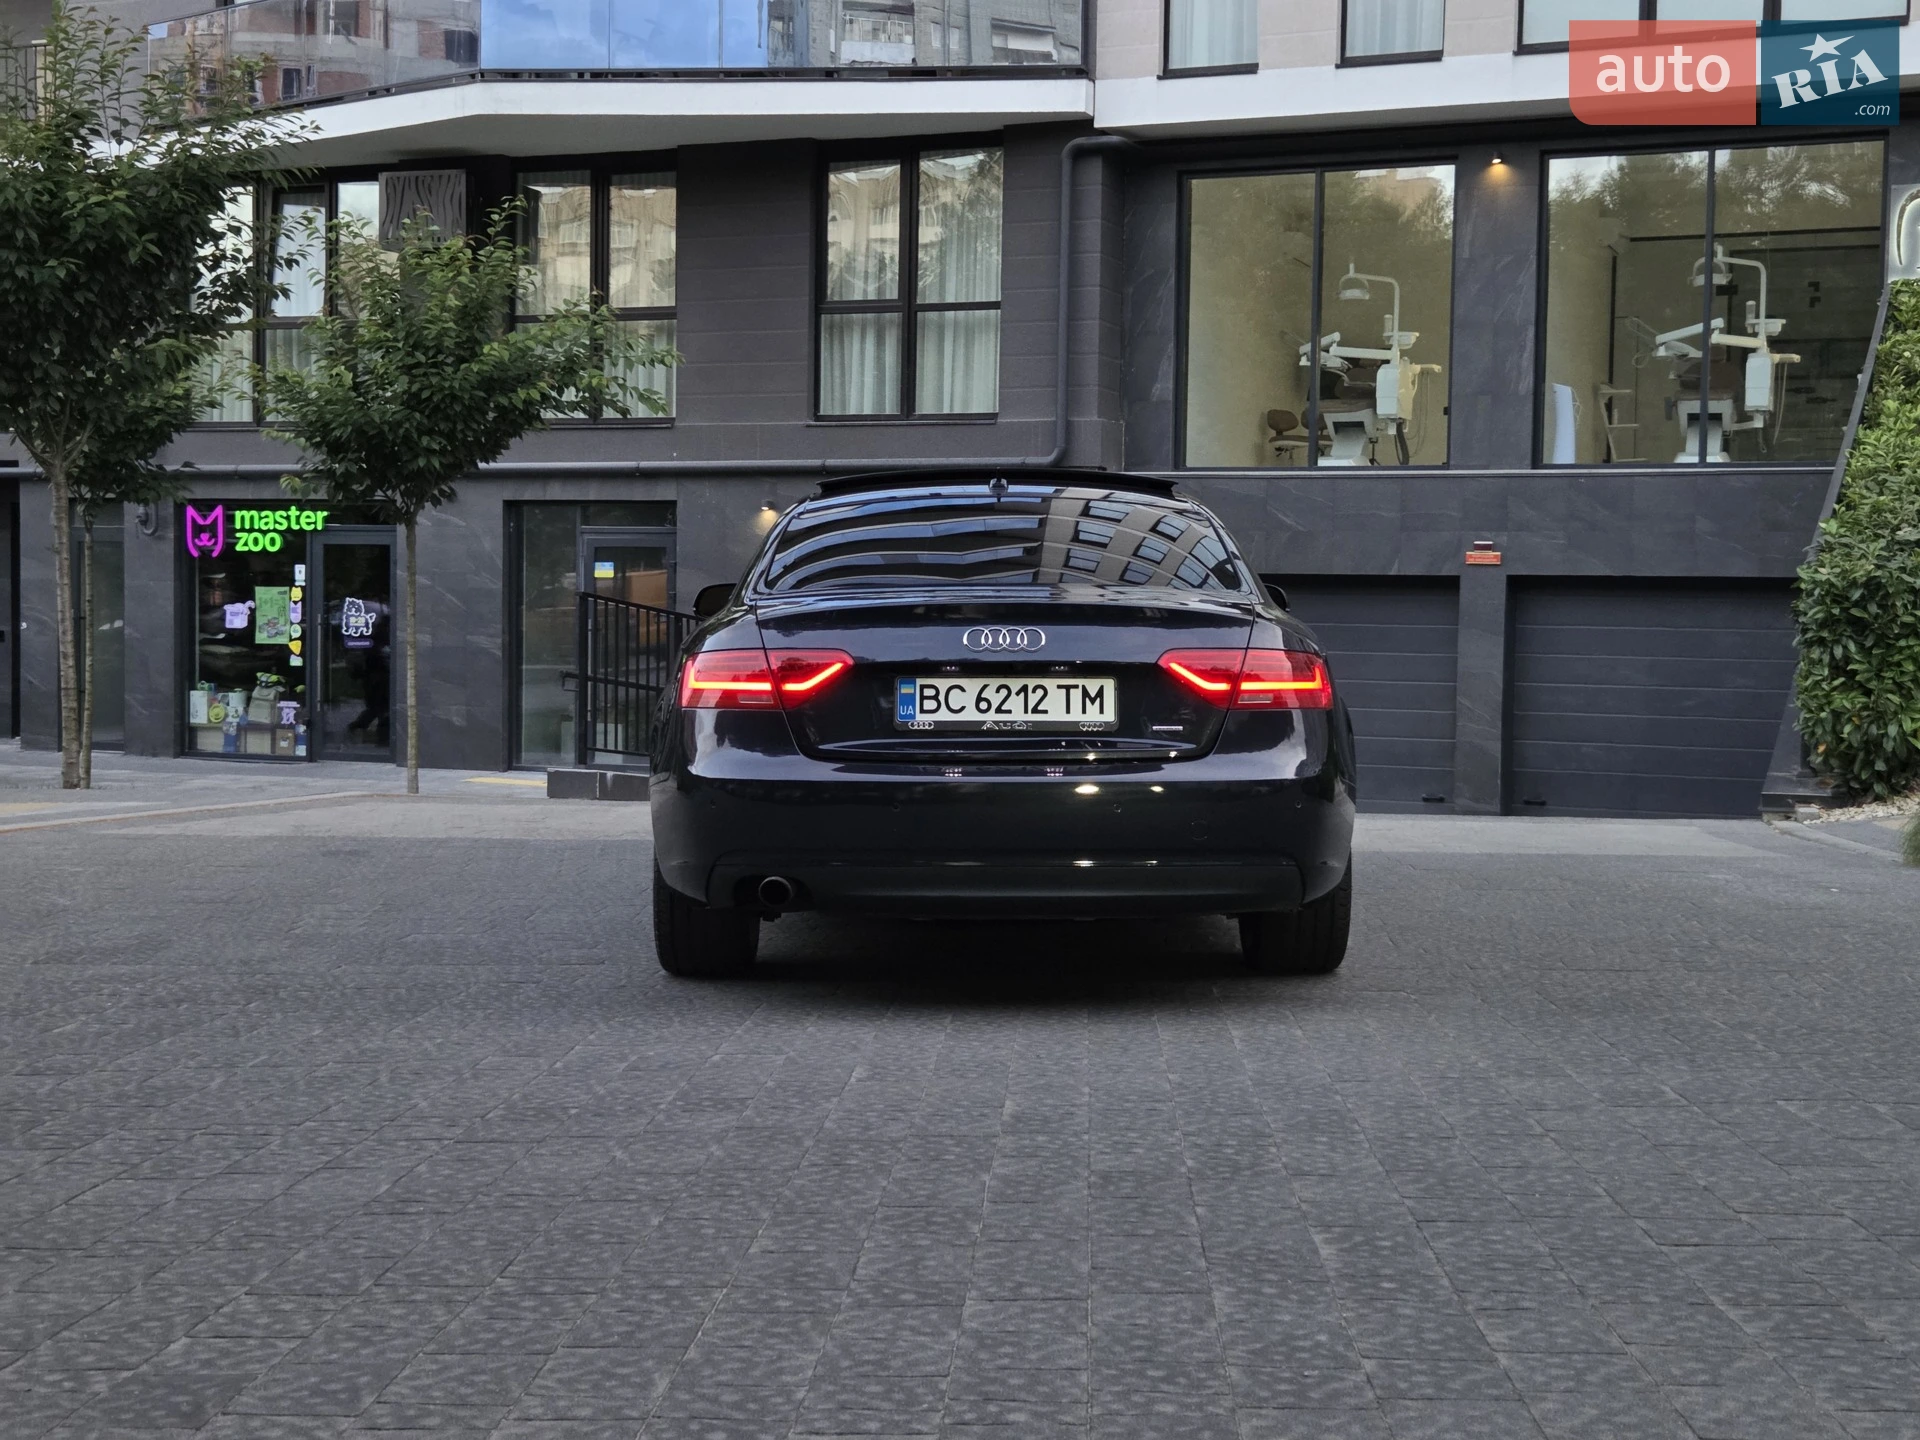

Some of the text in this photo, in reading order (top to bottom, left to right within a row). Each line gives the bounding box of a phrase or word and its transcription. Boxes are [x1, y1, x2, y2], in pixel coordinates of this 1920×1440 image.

[234, 505, 328, 531] master
[234, 532, 283, 553] zoo
[900, 705, 914, 715] UA
[919, 684, 1105, 715] BC 6212 TM
